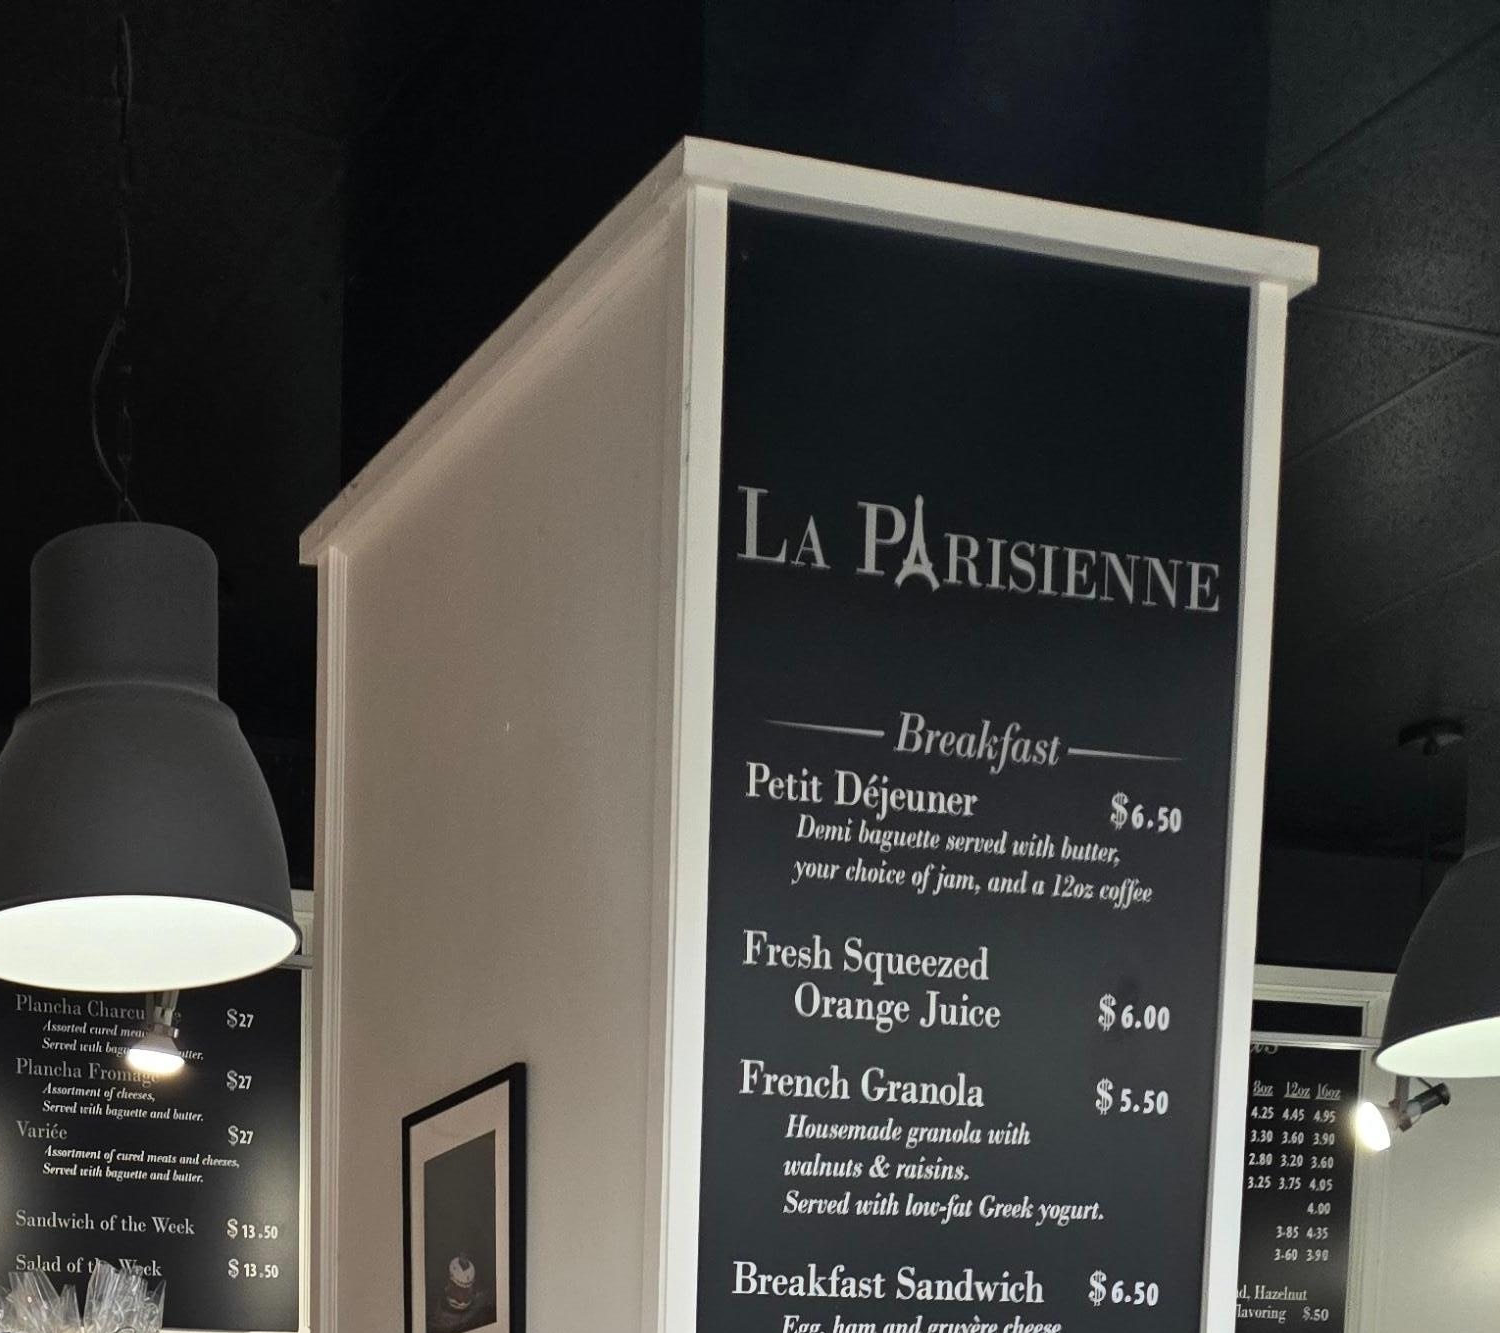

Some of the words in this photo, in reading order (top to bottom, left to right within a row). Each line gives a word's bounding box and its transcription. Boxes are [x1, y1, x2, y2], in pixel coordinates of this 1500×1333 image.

[894, 712, 1060, 774] Breakfast
[746, 762, 822, 801] Petit
[835, 770, 977, 820] Déjeuner
[1111, 792, 1181, 832] $6.50
[797, 814, 852, 841] Demi
[859, 824, 940, 852] baguette
[946, 831, 1007, 854] served
[1013, 835, 1054, 858] with
[1061, 839, 1119, 863] butter,
[792, 861, 840, 884] your
[846, 858, 905, 884] choice
[912, 865, 930, 894] of
[933, 865, 980, 895] jam,
[988, 872, 1027, 893] and
[1032, 881, 1044, 895] a
[1053, 874, 1093, 898] 12oz
[1100, 879, 1152, 909] coffee
[743, 930, 832, 969] Fresh
[844, 938, 988, 985] Squeezed
[15, 994, 81, 1016] Plancha
[795, 982, 909, 1033] Orange
[920, 991, 1000, 1027] Juice
[1098, 994, 1169, 1031] $6.00
[15, 1058, 82, 1079] Plancha
[42, 1083, 101, 1097] Assortment
[104, 1087, 115, 1100] of
[117, 1088, 156, 1102] cheeses,
[739, 1059, 850, 1099] French
[862, 1067, 984, 1107] Granola
[1096, 1079, 1168, 1114] $5.50
[1251, 1106, 1275, 1121] 4.25
[1282, 1108, 1305, 1122] 4.45
[1313, 1109, 1336, 1123] 4.95
[16, 1120, 68, 1140] Variée
[785, 1114, 902, 1141] Housemade
[906, 1123, 981, 1148] granola
[988, 1122, 1030, 1145] with
[1282, 1131, 1304, 1145] 3.60
[783, 1154, 863, 1177] walnuts
[869, 1158, 890, 1178] &
[896, 1156, 969, 1180] raisins.
[1311, 1155, 1334, 1170] 3.60
[1247, 1176, 1272, 1190] 3.25
[1278, 1177, 1301, 1191] 3.75
[783, 1190, 850, 1214] Served
[855, 1193, 898, 1215] with
[906, 1193, 972, 1224] low-fat
[979, 1195, 1033, 1218] Greek
[1036, 1203, 1103, 1226] yogurt.
[1307, 1201, 1331, 1215] 4.00
[15, 1210, 95, 1230] Sandwich
[100, 1215, 118, 1231] of
[121, 1216, 146, 1232] the
[151, 1216, 195, 1235] Week
[1306, 1227, 1329, 1241] 4.35
[15, 1254, 61, 1273] Salad
[67, 1258, 85, 1273] of
[1274, 1248, 1298, 1263] 3.60
[732, 1261, 885, 1298] Breakfast
[896, 1266, 1044, 1303] Sandwich
[1089, 1270, 1158, 1306] $6.50
[1254, 1284, 1307, 1300] Hazelnut
